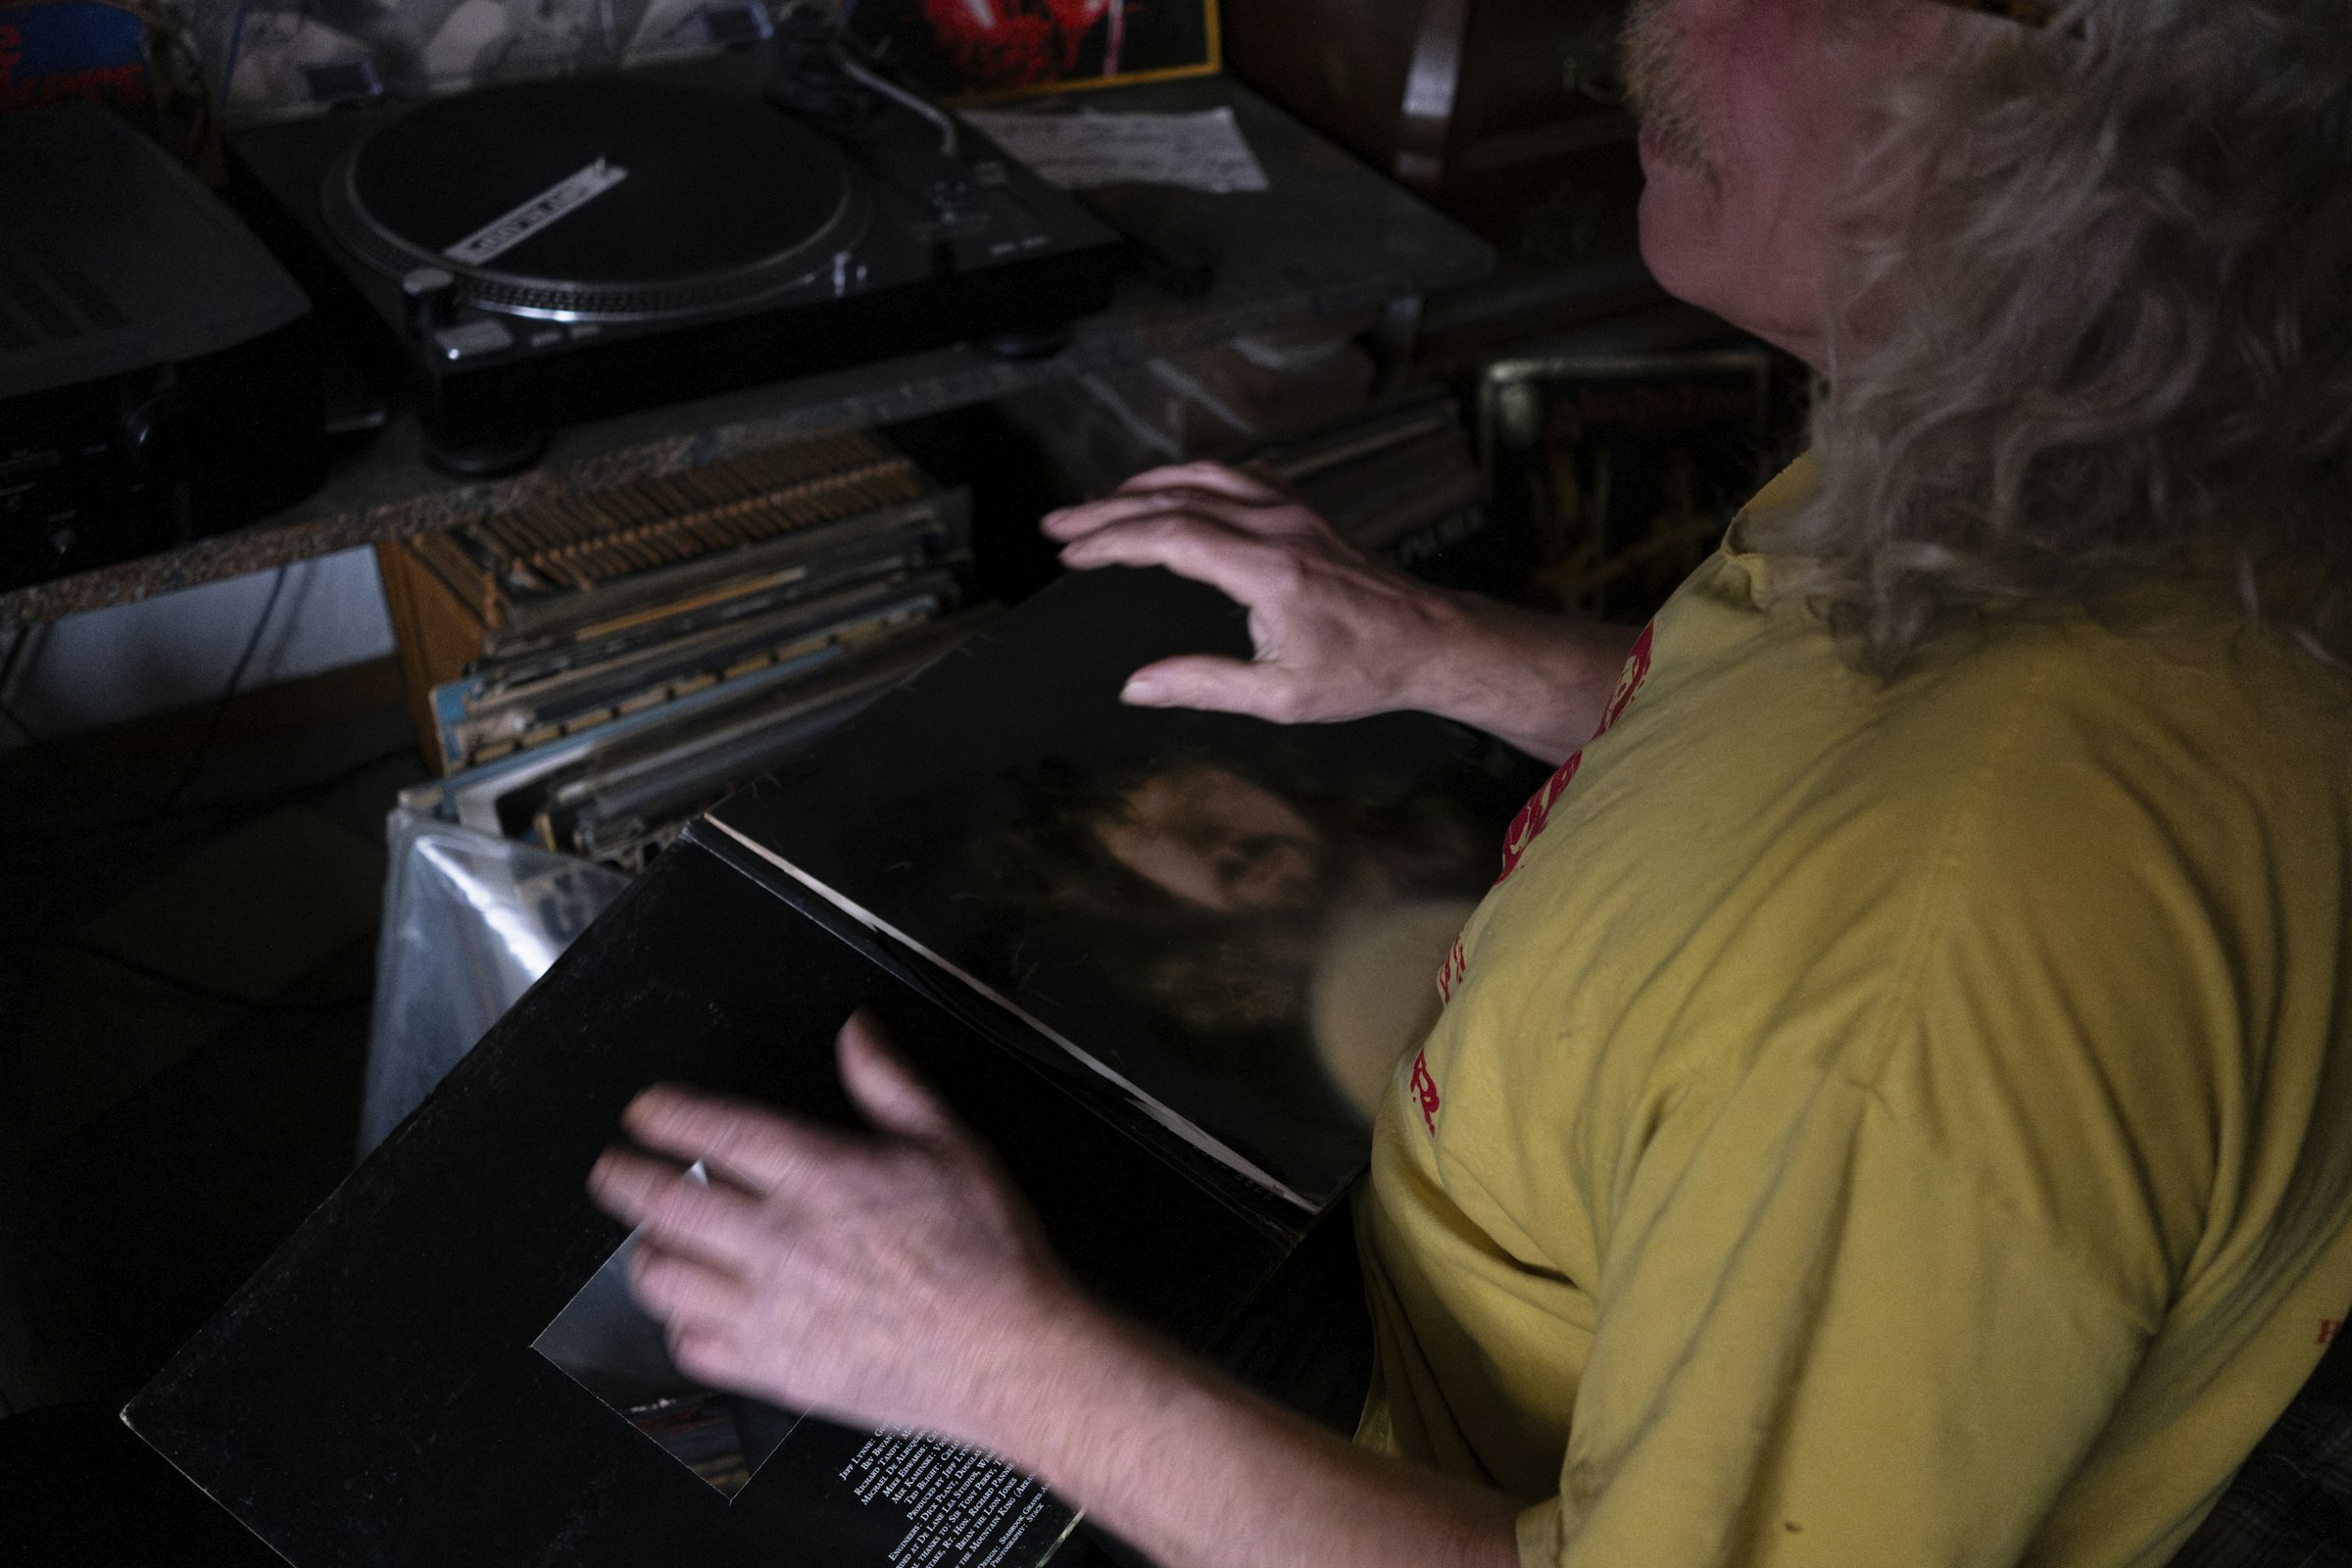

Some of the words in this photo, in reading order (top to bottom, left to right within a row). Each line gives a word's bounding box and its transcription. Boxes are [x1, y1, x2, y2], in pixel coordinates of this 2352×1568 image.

[838, 1463, 855, 1482] JEFF
[851, 1438, 876, 1464] LYNNE:
[853, 1466, 880, 1496] RICHARD
[877, 1441, 903, 1466] TANDY:
[859, 1455, 874, 1471] BEV
[860, 1476, 889, 1506] MICHAEL
[885, 1462, 899, 1476] DE
[882, 1477, 902, 1497] MIKE
[898, 1445, 928, 1478] EDWARDS:
[891, 1487, 907, 1504] MIK
[904, 1451, 937, 1488] KAMINSKI:
[903, 1490, 919, 1504] TED
[916, 1462, 943, 1491] BLIGHT:
[940, 1440, 960, 1461] CELLO
[906, 1487, 937, 1521] PRODUCED
[934, 1476, 945, 1488] BY
[941, 1461, 956, 1479] JEFF
[888, 1522, 922, 1561] ENGINEERS:
[919, 1502, 939, 1522] DICK
[935, 1480, 959, 1503] PLANT,
[955, 1448, 982, 1480] DOUGLAS
[910, 1543, 920, 1554] AT
[916, 1531, 930, 1544] DE
[925, 1512, 945, 1533] LANE
[941, 1498, 956, 1513] LEA
[953, 1471, 981, 1499] STUDIOS,
[917, 1536, 941, 1561] THANKS
[938, 1522, 952, 1536] TO:
[948, 1509, 962, 1524] SIR
[957, 1490, 978, 1509] TONY
[974, 1468, 998, 1491] PERRY,
[942, 1536, 956, 1549] RT.
[952, 1517, 971, 1536] HON.
[967, 1487, 995, 1517] RICHARD
[955, 1528, 976, 1551] BRIAN
[972, 1515, 987, 1529] THE
[983, 1496, 1002, 1516] LION
[998, 1477, 1017, 1499] JONES
[957, 1551, 973, 1566] THE
[969, 1515, 1001, 1552] MOUNTAIN
[997, 1496, 1016, 1517] KING
[990, 1523, 1028, 1568] PHOTOGRAPHY:
[1026, 1502, 1045, 1523] STACK
